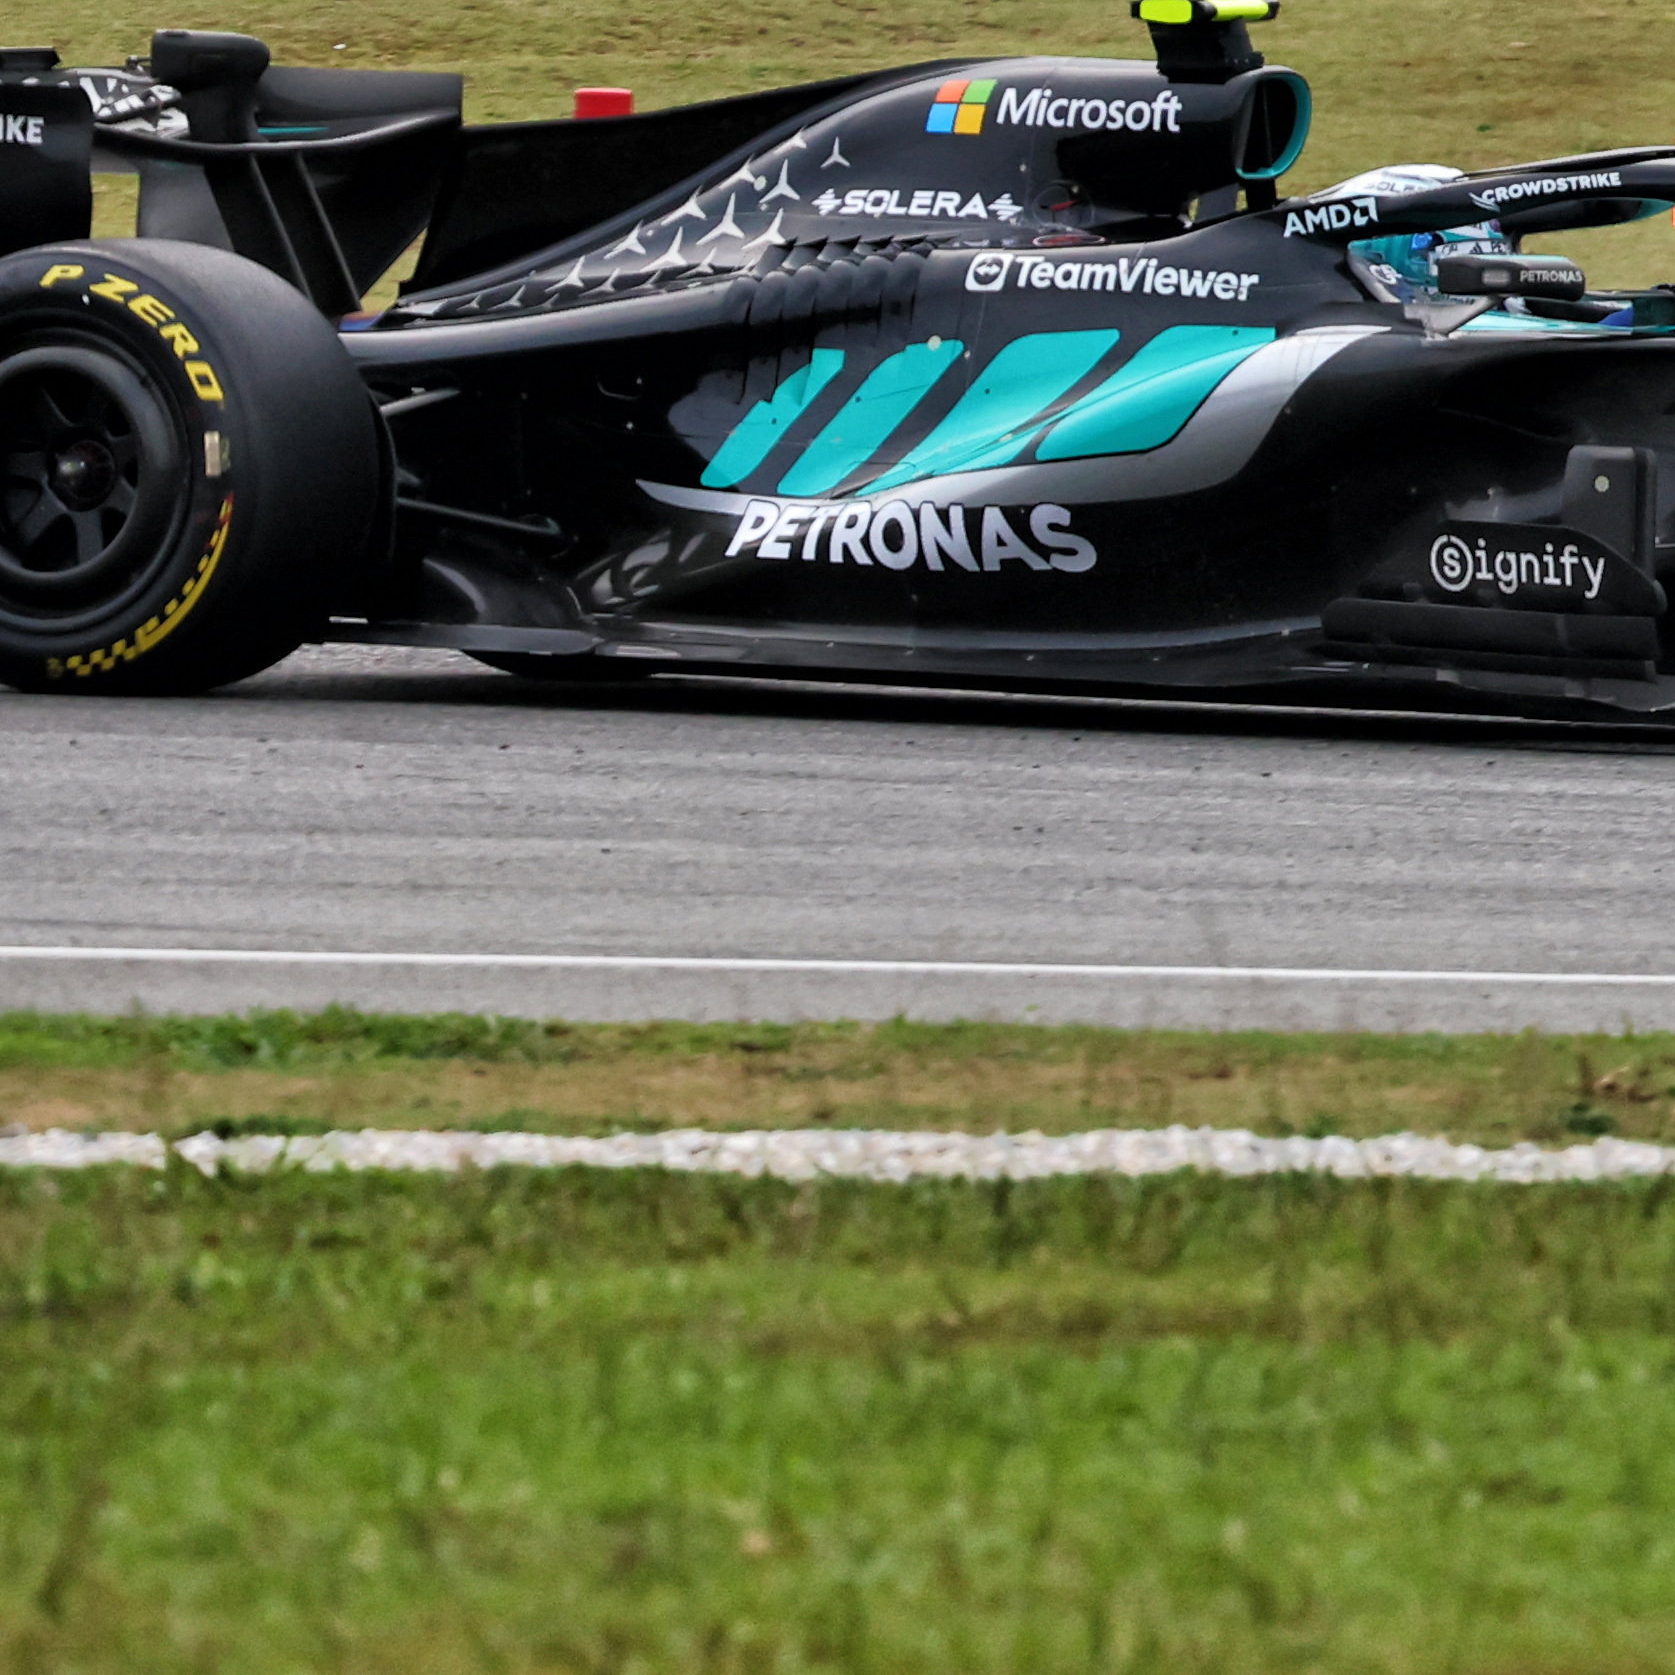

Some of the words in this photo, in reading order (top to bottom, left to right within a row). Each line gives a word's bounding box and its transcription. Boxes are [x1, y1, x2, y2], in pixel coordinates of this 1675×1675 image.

[996, 89, 1183, 132] Microsoft
[843, 189, 989, 220] SOLERA
[1481, 172, 1622, 205] CROWDSTRIKE
[1283, 202, 1353, 238] AMD
[1015, 256, 1260, 301] TeamViewer
[1519, 269, 1584, 283] PETRONAS
[40, 264, 85, 288] P
[89, 273, 225, 402] ZERO
[724, 499, 1097, 573] PETRONAS
